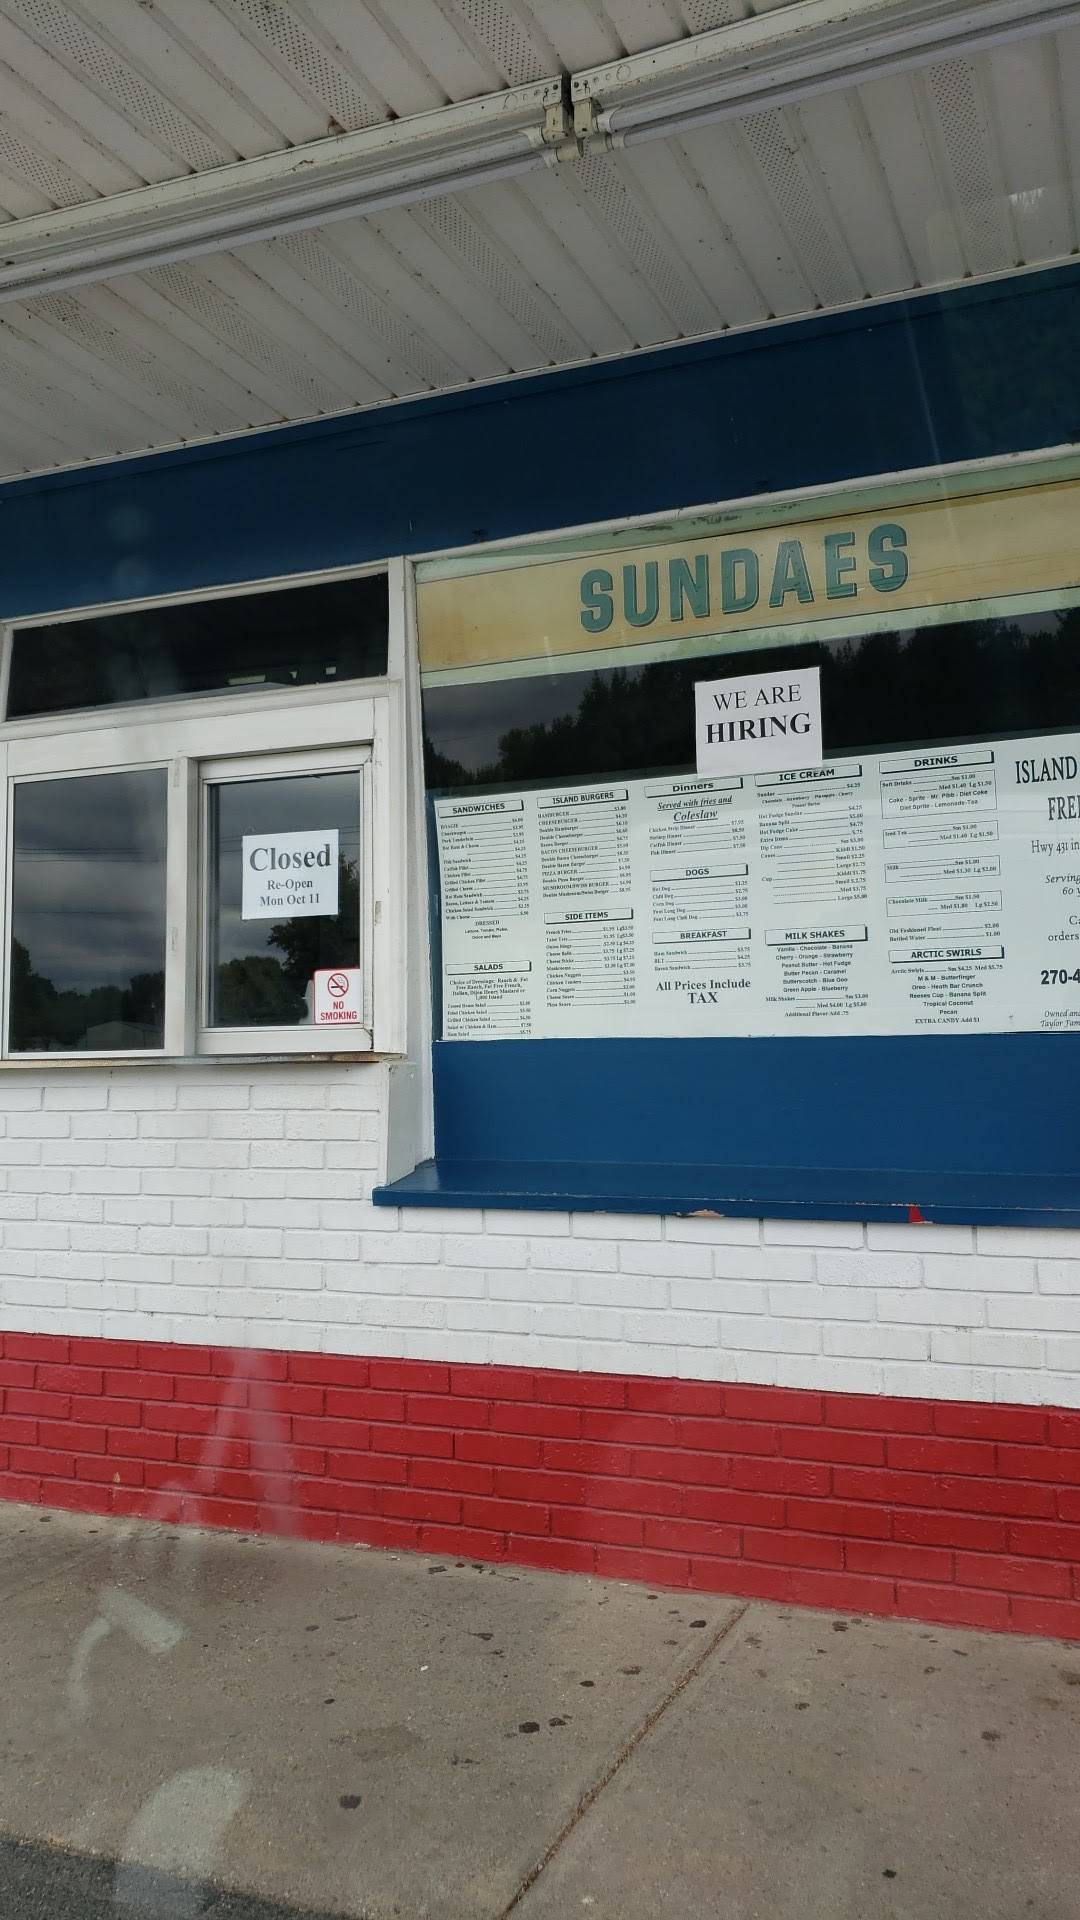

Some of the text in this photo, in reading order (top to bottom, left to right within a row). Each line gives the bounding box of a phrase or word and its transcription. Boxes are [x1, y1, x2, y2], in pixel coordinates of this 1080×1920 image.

[579, 523, 909, 633] SUNDAES
[713, 684, 802, 710] WE ARE
[705, 712, 811, 745] HIRING
[914, 756, 958, 767] DRINKS
[779, 769, 835, 781] ICE CREAM
[1015, 756, 1077, 784] ISLAND
[673, 782, 714, 792] Dinners
[552, 792, 614, 804] ISLAND BURGERS
[657, 801, 681, 810] Served
[700, 798, 716, 807] fries
[718, 795, 732, 803] and
[453, 803, 505, 814] SANDWICHES
[1048, 794, 1080, 820] FRE
[673, 810, 718, 821] Coleslaw
[1031, 838, 1080, 856] Hwy 431 in
[250, 844, 332, 871] Closed
[686, 868, 710, 876] DOGS
[267, 879, 313, 890] Re-Open
[1062, 886, 1073, 895] 60
[260, 893, 320, 906] Mon Oct 11
[680, 931, 727, 939] BREAKFAST
[785, 930, 845, 940] MILK SHAKES
[1048, 931, 1079, 941] orders
[911, 948, 981, 959] ARCTIC SWIRLS
[656, 979, 751, 991] All Prices Include
[688, 992, 718, 1004] TAX
[333, 1001, 344, 1010] NO
[320, 1011, 357, 1021] SMOKING
